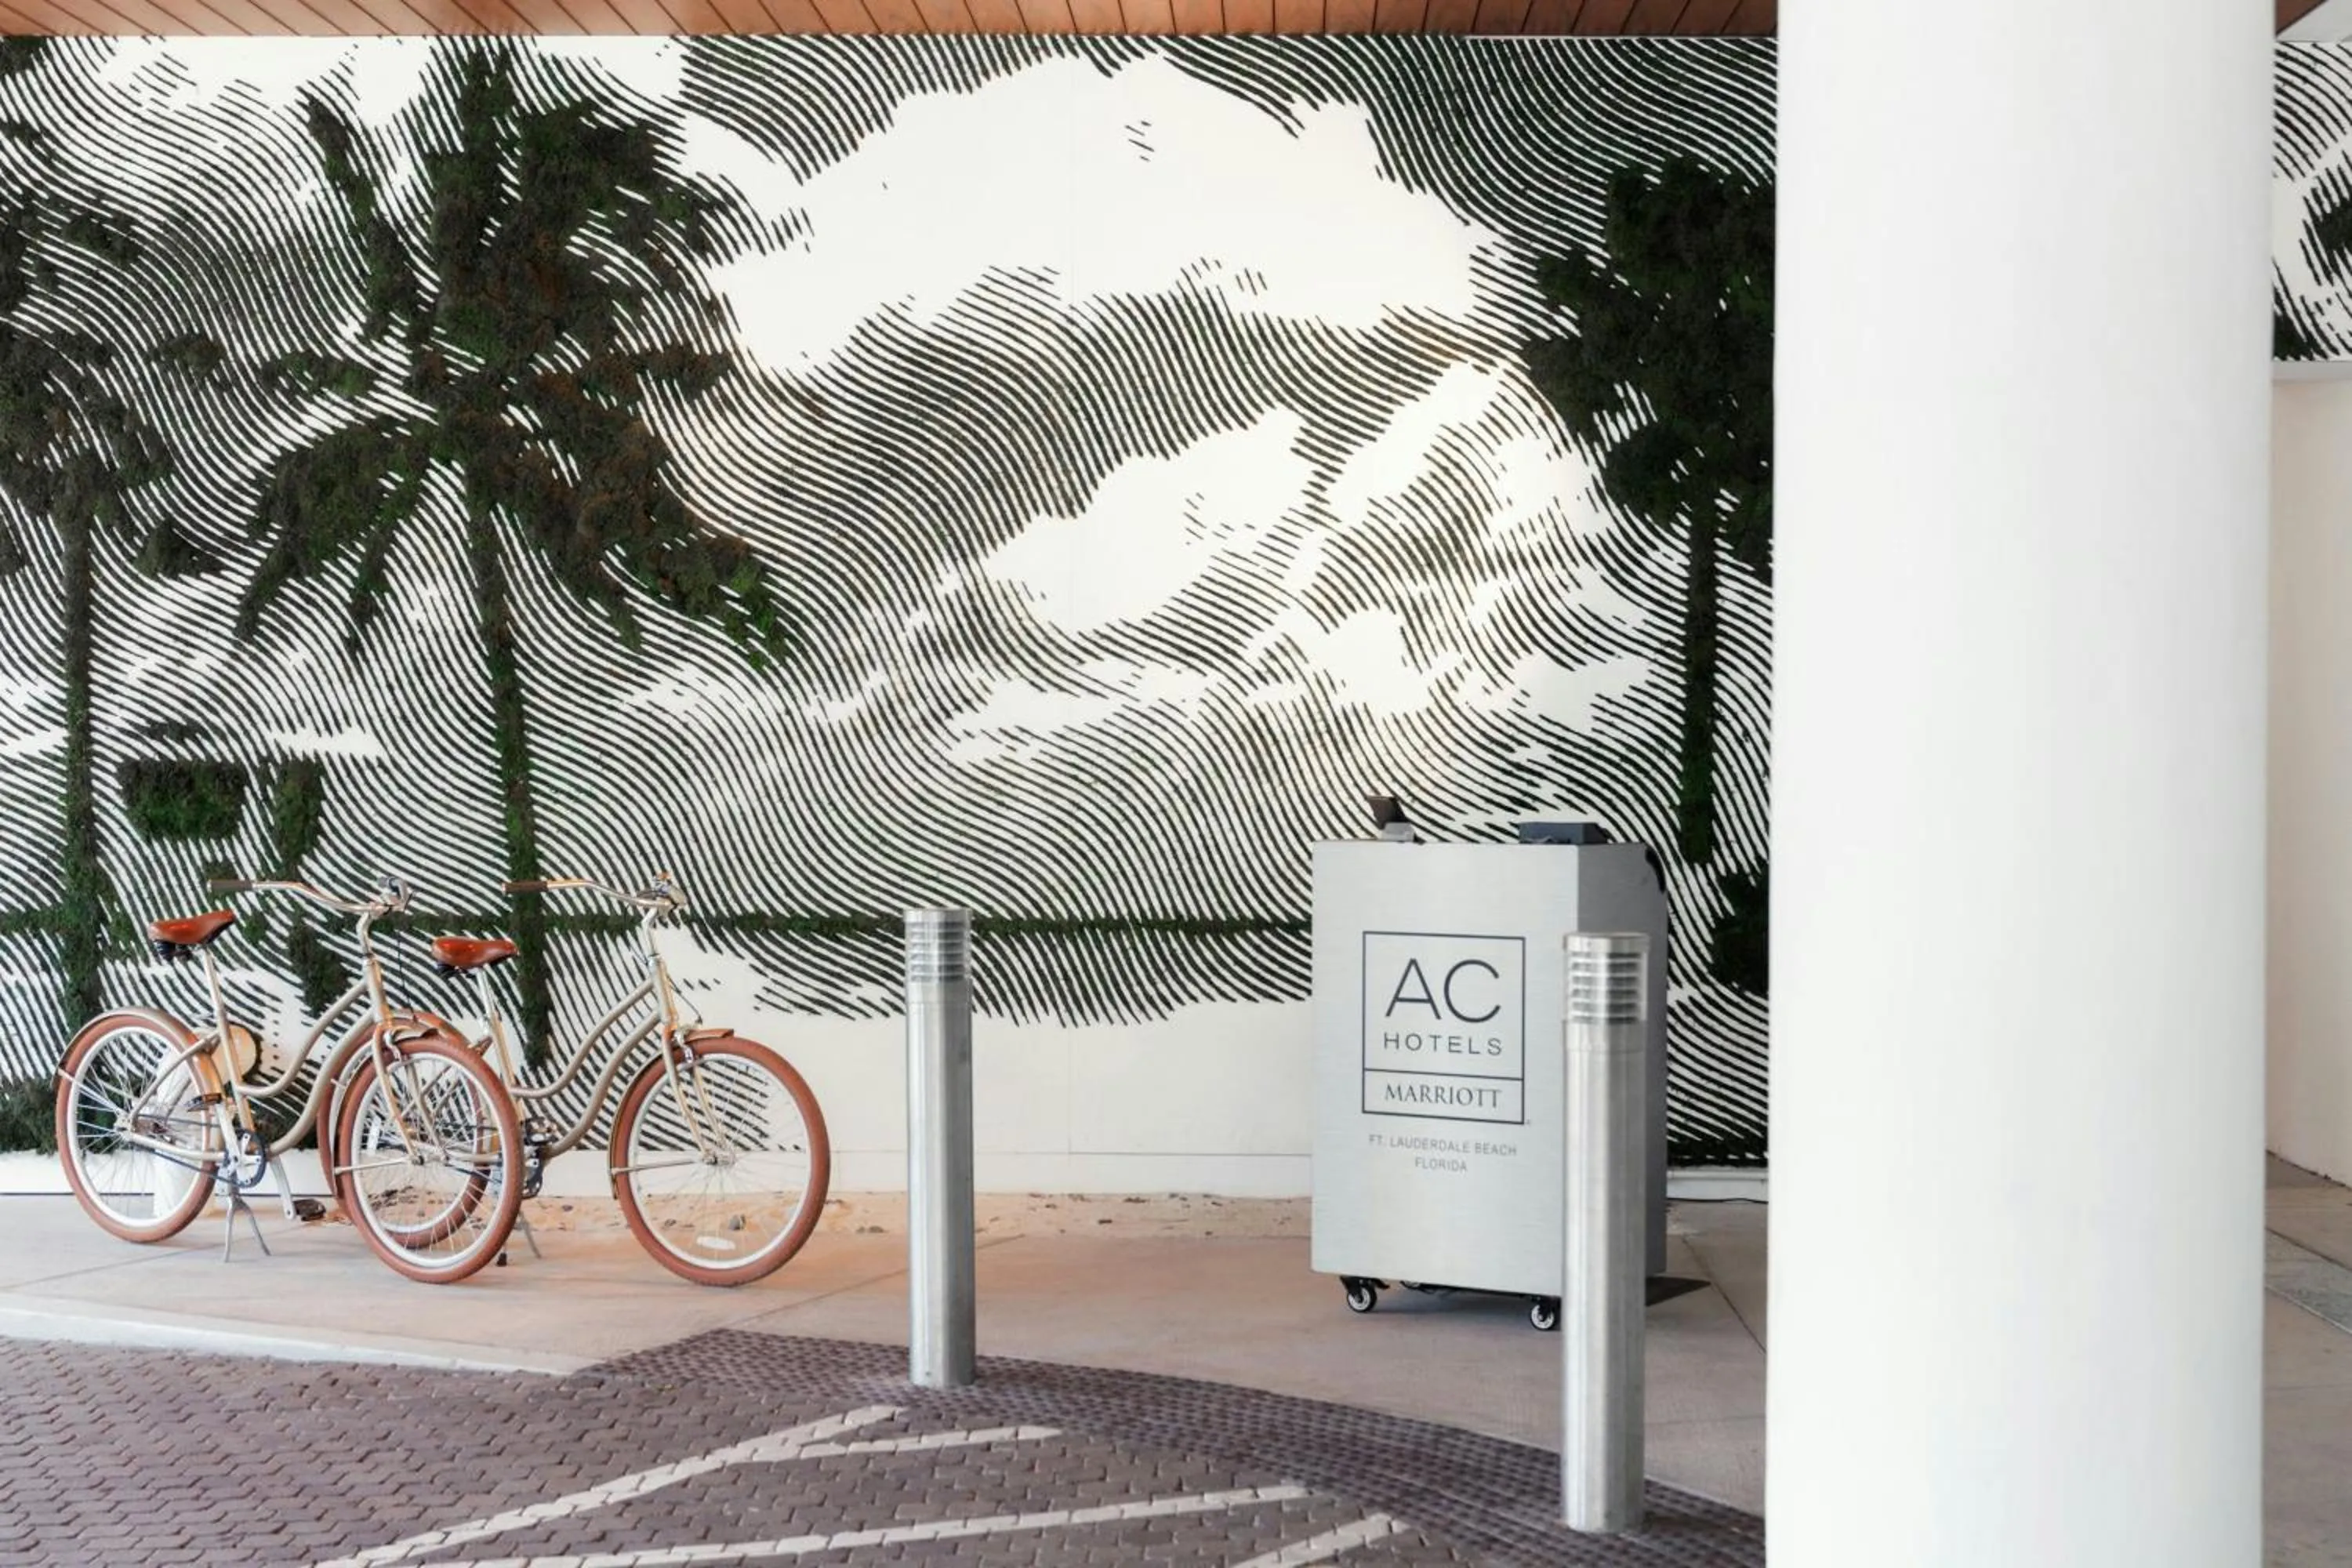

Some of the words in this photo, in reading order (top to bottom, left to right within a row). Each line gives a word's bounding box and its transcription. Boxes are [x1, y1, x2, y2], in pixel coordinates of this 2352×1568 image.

[1385, 958, 1501, 1023] AC
[1383, 1032, 1502, 1056] HOTELS
[1385, 1083, 1503, 1109] MARRIOTT
[1389, 1136, 1472, 1153] LAUDERDALE
[1475, 1142, 1518, 1156] BEACH
[1414, 1156, 1468, 1172] FLORIDA
